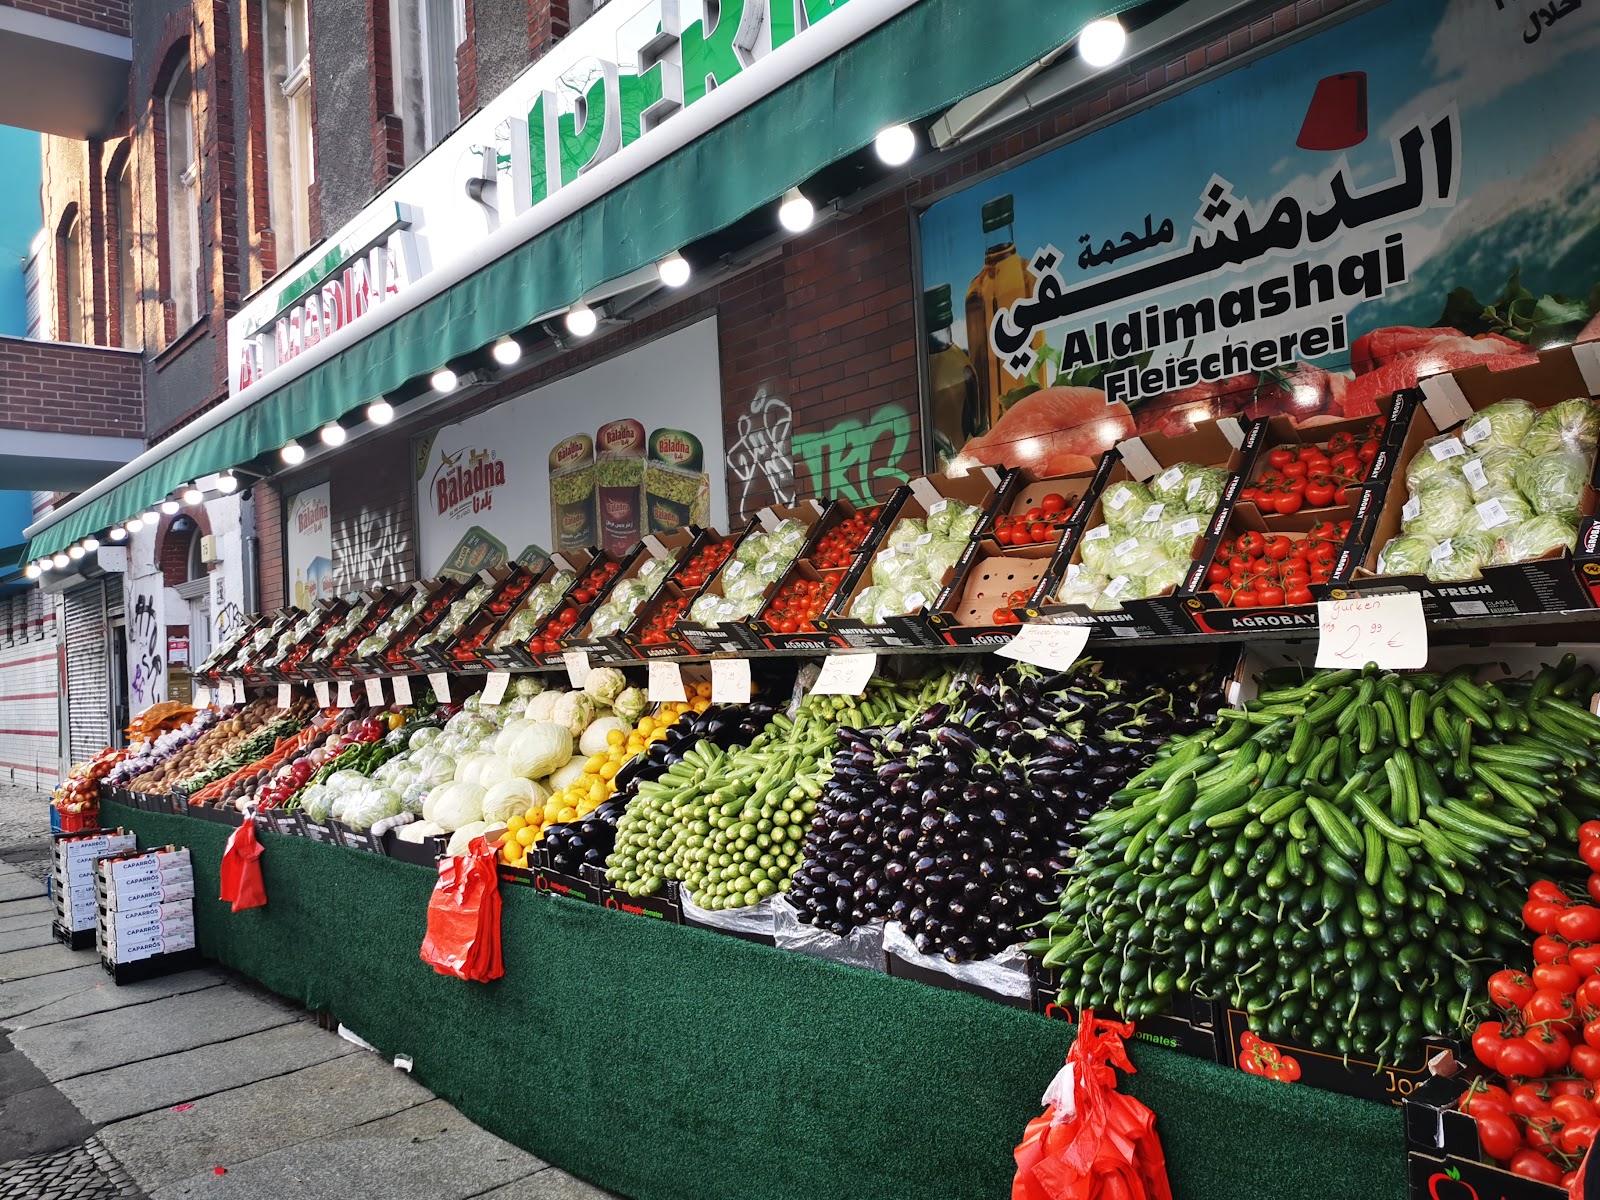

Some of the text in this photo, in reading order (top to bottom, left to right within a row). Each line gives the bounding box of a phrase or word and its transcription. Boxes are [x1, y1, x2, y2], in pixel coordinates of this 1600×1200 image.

[1078, 213, 1174, 270] ملحمة
[1061, 233, 1405, 370] Aldimashqi
[1107, 315, 1346, 403] Fleischerei
[659, 440, 690, 454] Baladna
[437, 458, 506, 516] Baladna
[1438, 585, 1494, 598] FRESH
[1097, 614, 1134, 623] FRESH
[1231, 613, 1317, 629] AGROBAY
[870, 627, 897, 635] FRESH
[783, 641, 827, 649] AGROBAY
[971, 633, 1016, 646] AGROB
